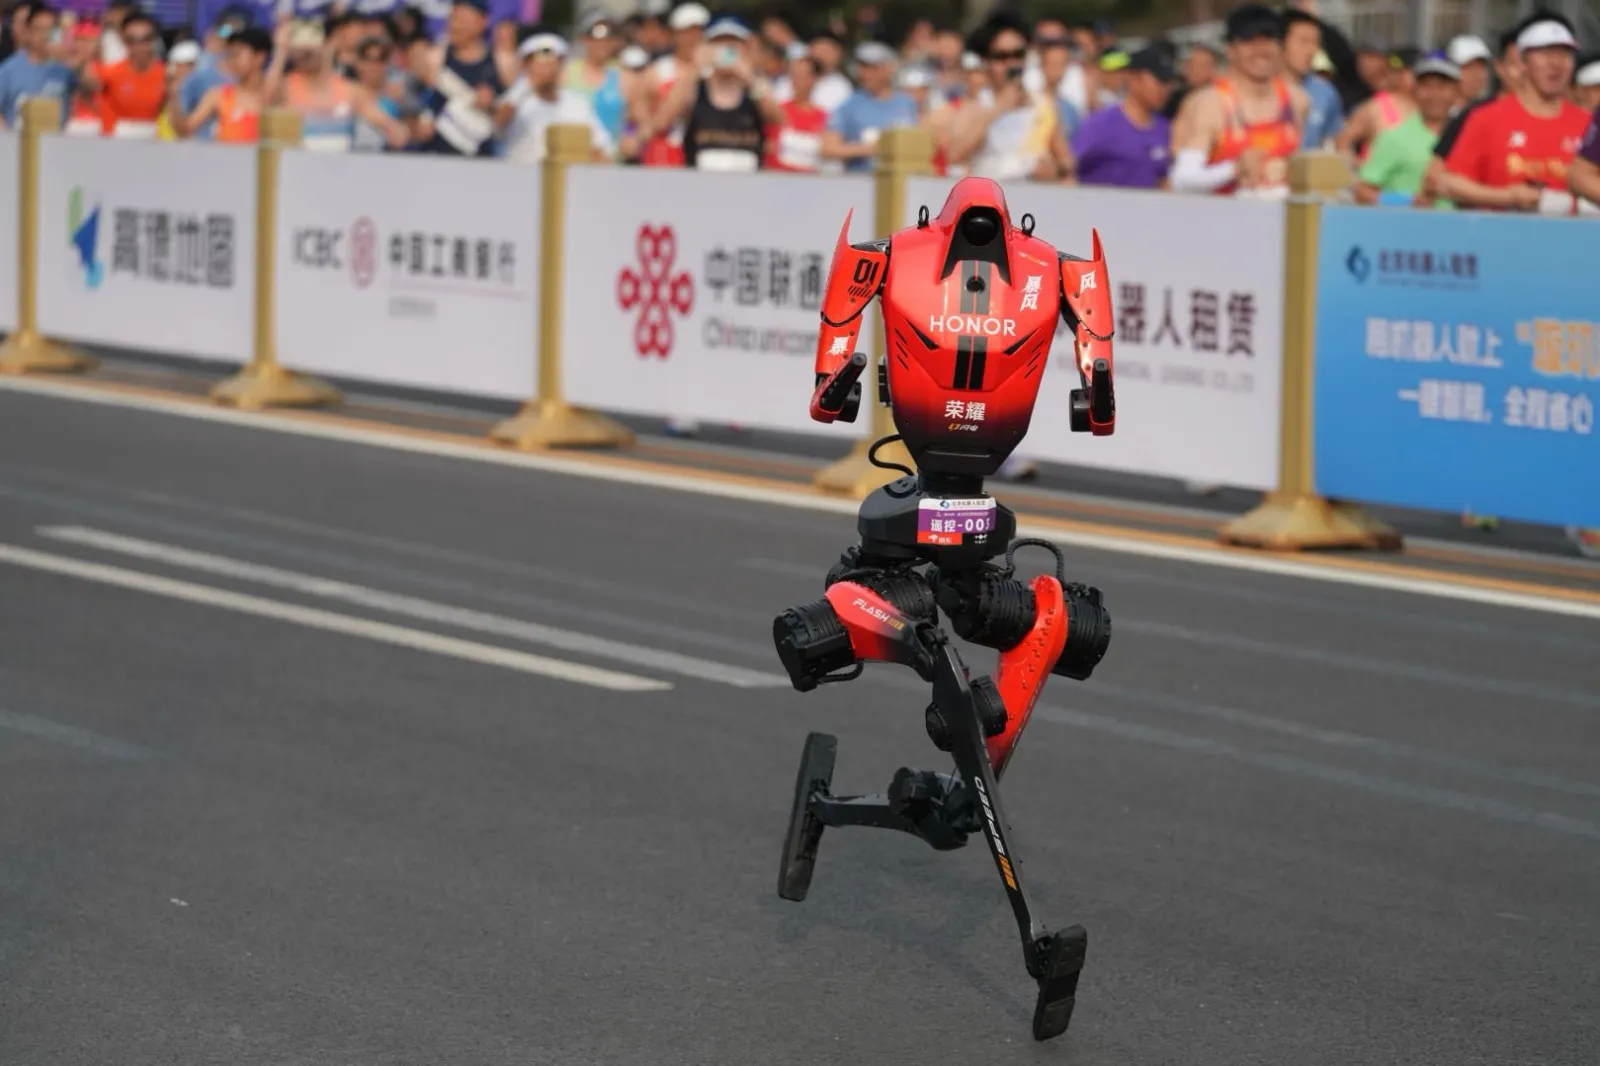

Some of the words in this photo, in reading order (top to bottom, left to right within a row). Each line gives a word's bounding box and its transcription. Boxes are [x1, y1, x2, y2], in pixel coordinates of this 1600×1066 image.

[293, 226, 344, 270] ICBC
[388, 231, 517, 286] 中国工商银行
[704, 246, 824, 311] 中国联通
[853, 258, 880, 286] 01
[1080, 271, 1097, 294] 风
[1020, 275, 1043, 312] 暴风
[929, 315, 1017, 336] HONOR
[825, 335, 849, 355] 暴
[944, 400, 986, 420] 荣耀
[852, 598, 890, 622] FLASH
[974, 776, 1005, 855] SPEED
